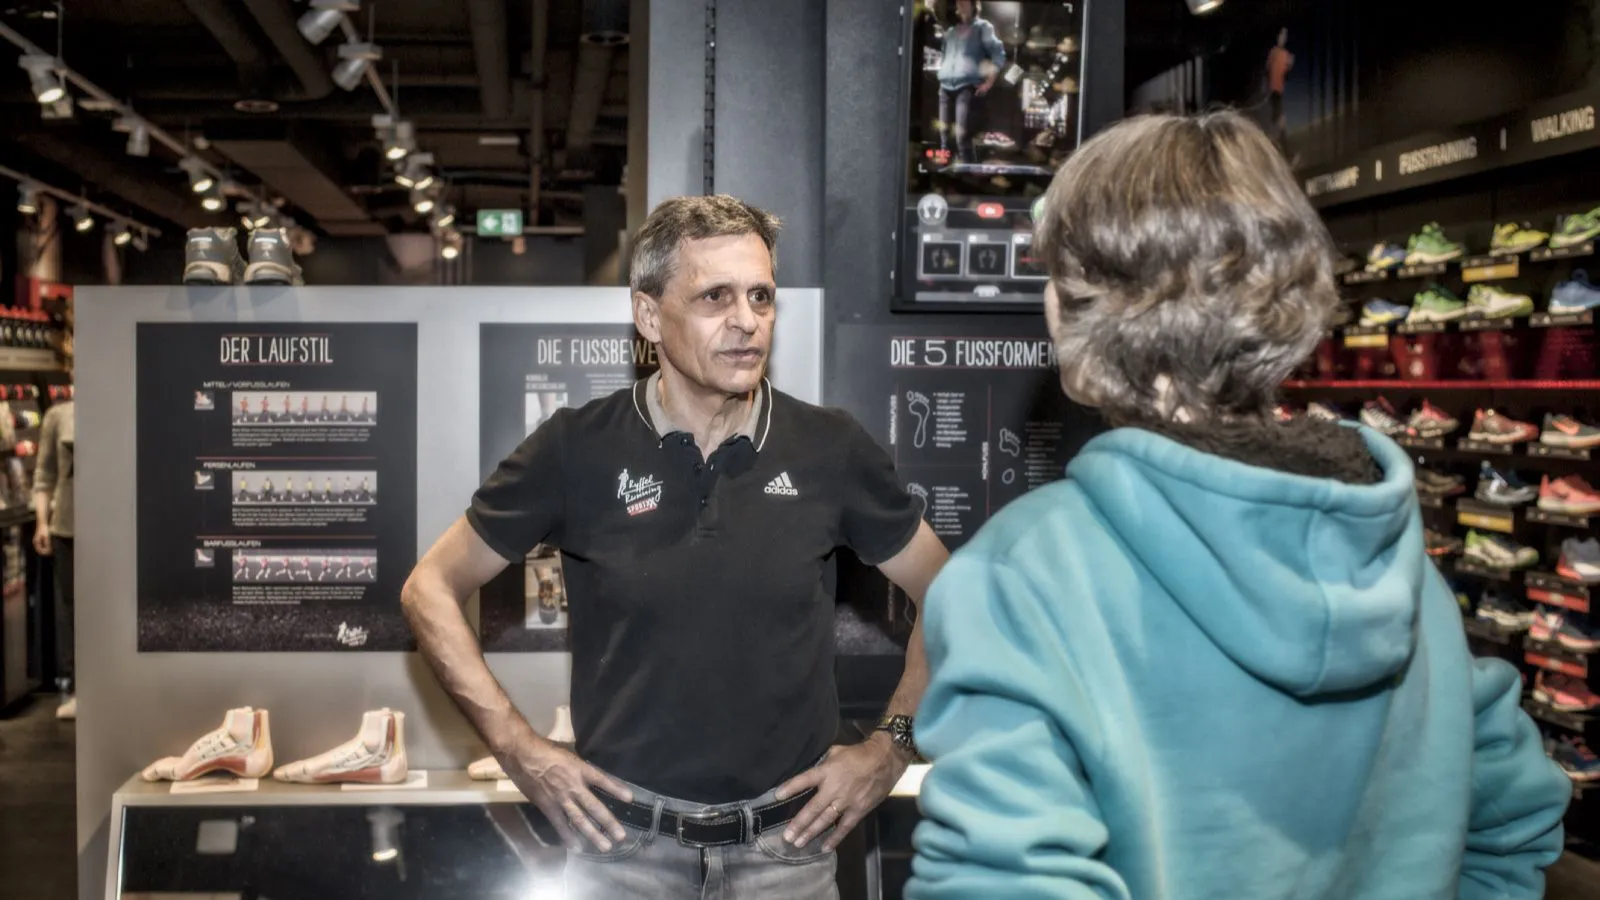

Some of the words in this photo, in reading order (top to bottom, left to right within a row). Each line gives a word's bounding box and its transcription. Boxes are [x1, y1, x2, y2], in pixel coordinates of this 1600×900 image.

[1399, 136, 1478, 175] FUSSTRAINING
[1531, 105, 1595, 143] WALKING
[220, 336, 250, 363] DER
[258, 336, 334, 363] LAUFSTIL
[537, 338, 562, 365] DIE
[570, 338, 657, 365] FUSSBEWE
[890, 339, 916, 366] DIE
[923, 339, 948, 366] 5
[763, 485, 799, 496] adidas
